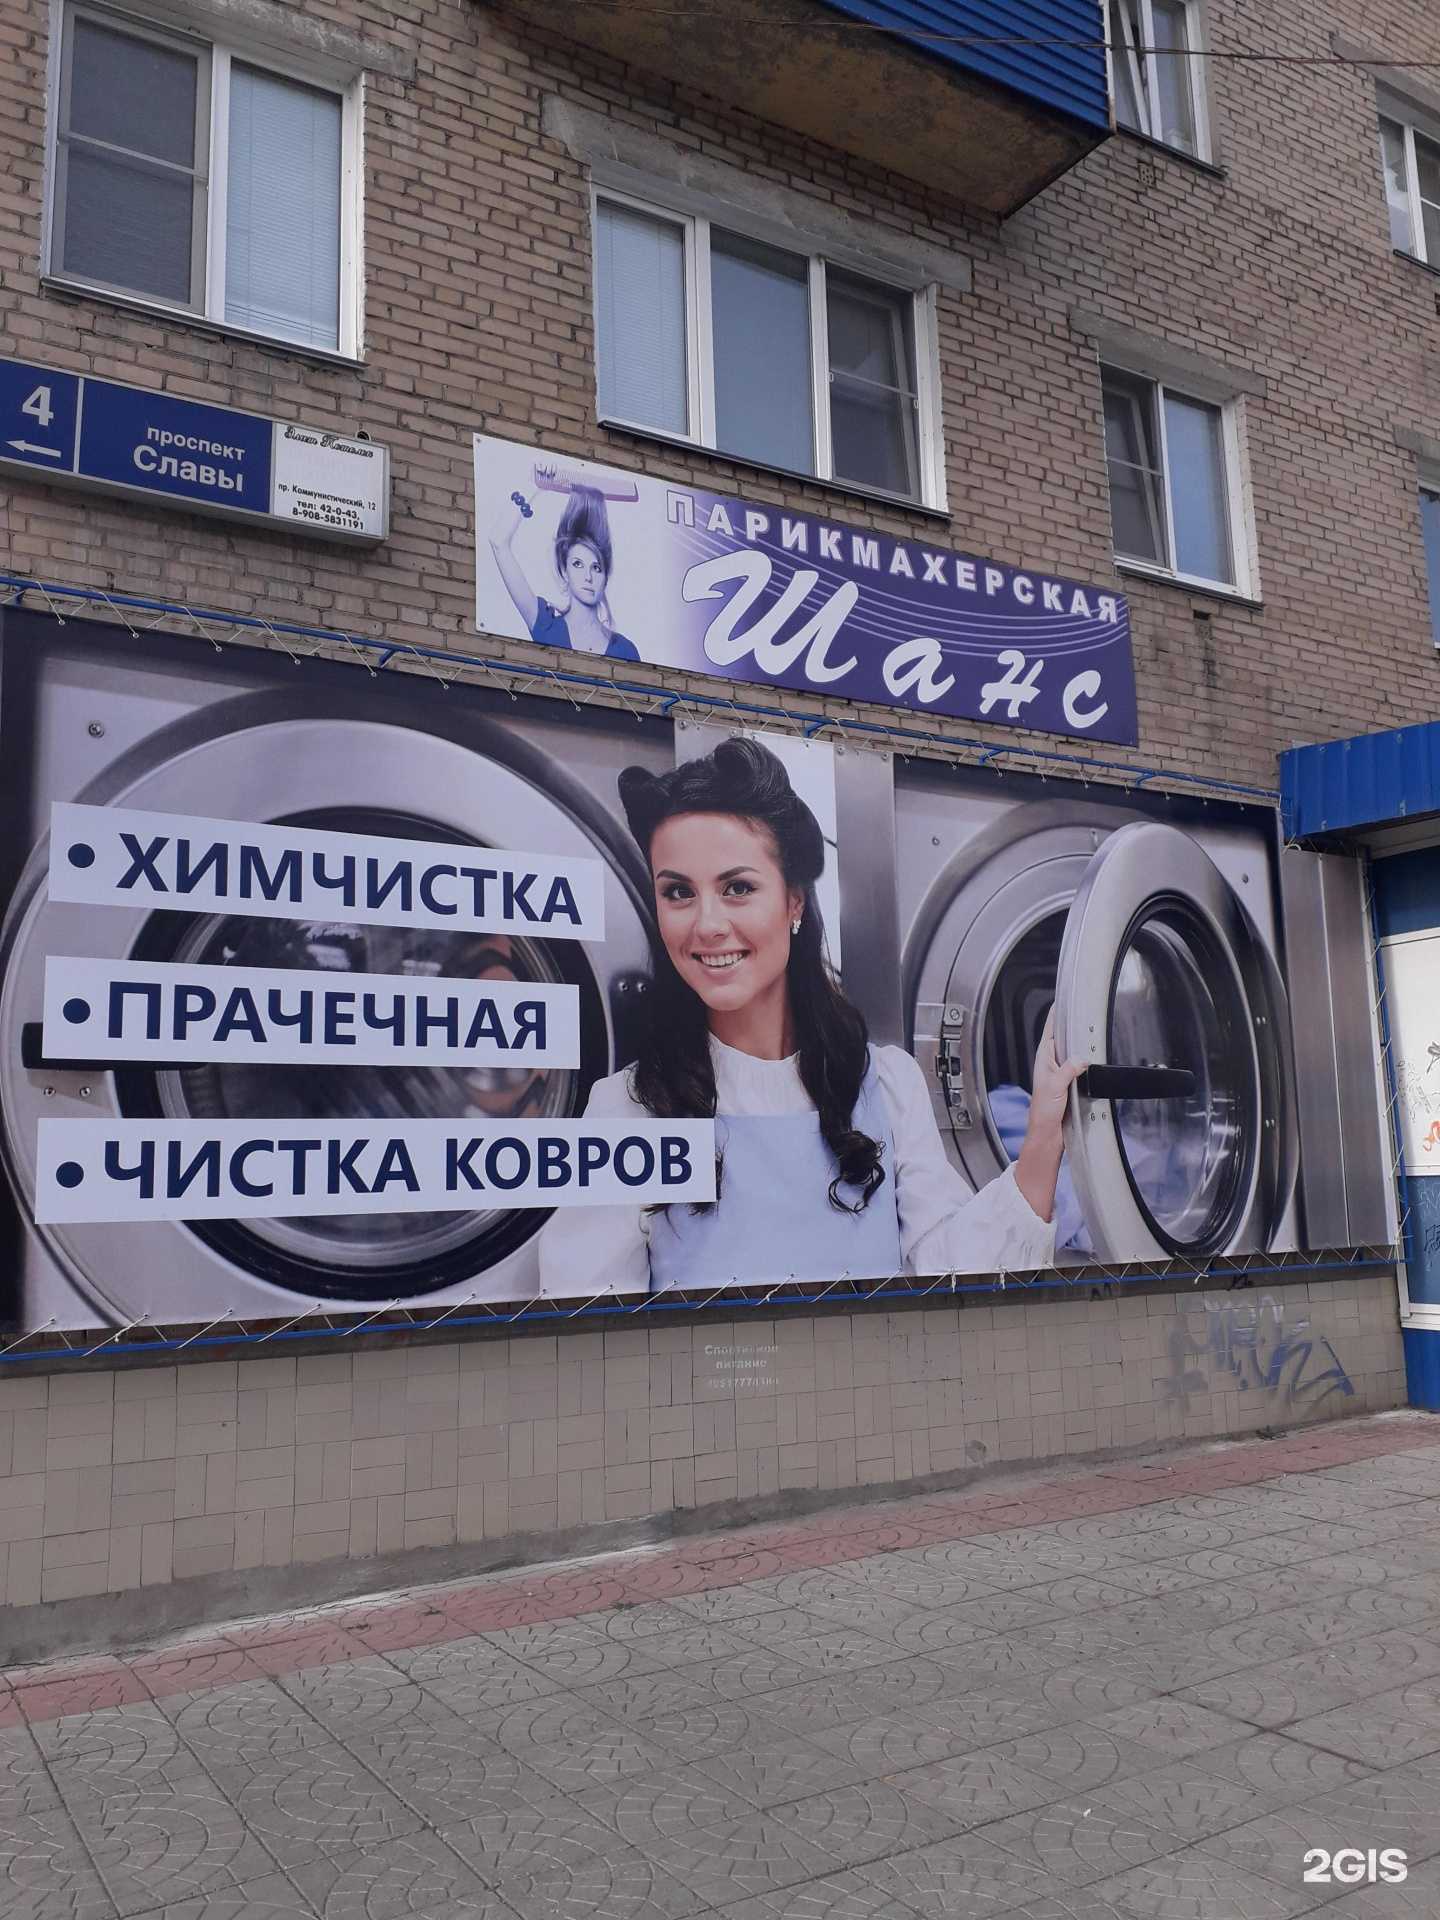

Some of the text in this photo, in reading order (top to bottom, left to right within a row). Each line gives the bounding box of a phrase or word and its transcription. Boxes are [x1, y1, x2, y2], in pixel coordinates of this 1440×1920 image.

[21, 386, 54, 426] 4
[147, 425, 246, 462] проспект
[133, 445, 244, 492] Славы
[278, 483, 376, 511] пр. Коммунистический, 12
[292, 507, 364, 530] 8-908-5831191
[297, 501, 317, 511] тел:
[667, 489, 1118, 624] ПАРИКМАХЕРСКАЯ
[682, 549, 1109, 729] Шанс
[116, 832, 583, 926] ХИМЧИСТКА
[108, 981, 547, 1051] ПРАЧЕЧНАЯ
[104, 1135, 693, 1200] ЧИСТКА КОВРОВ
